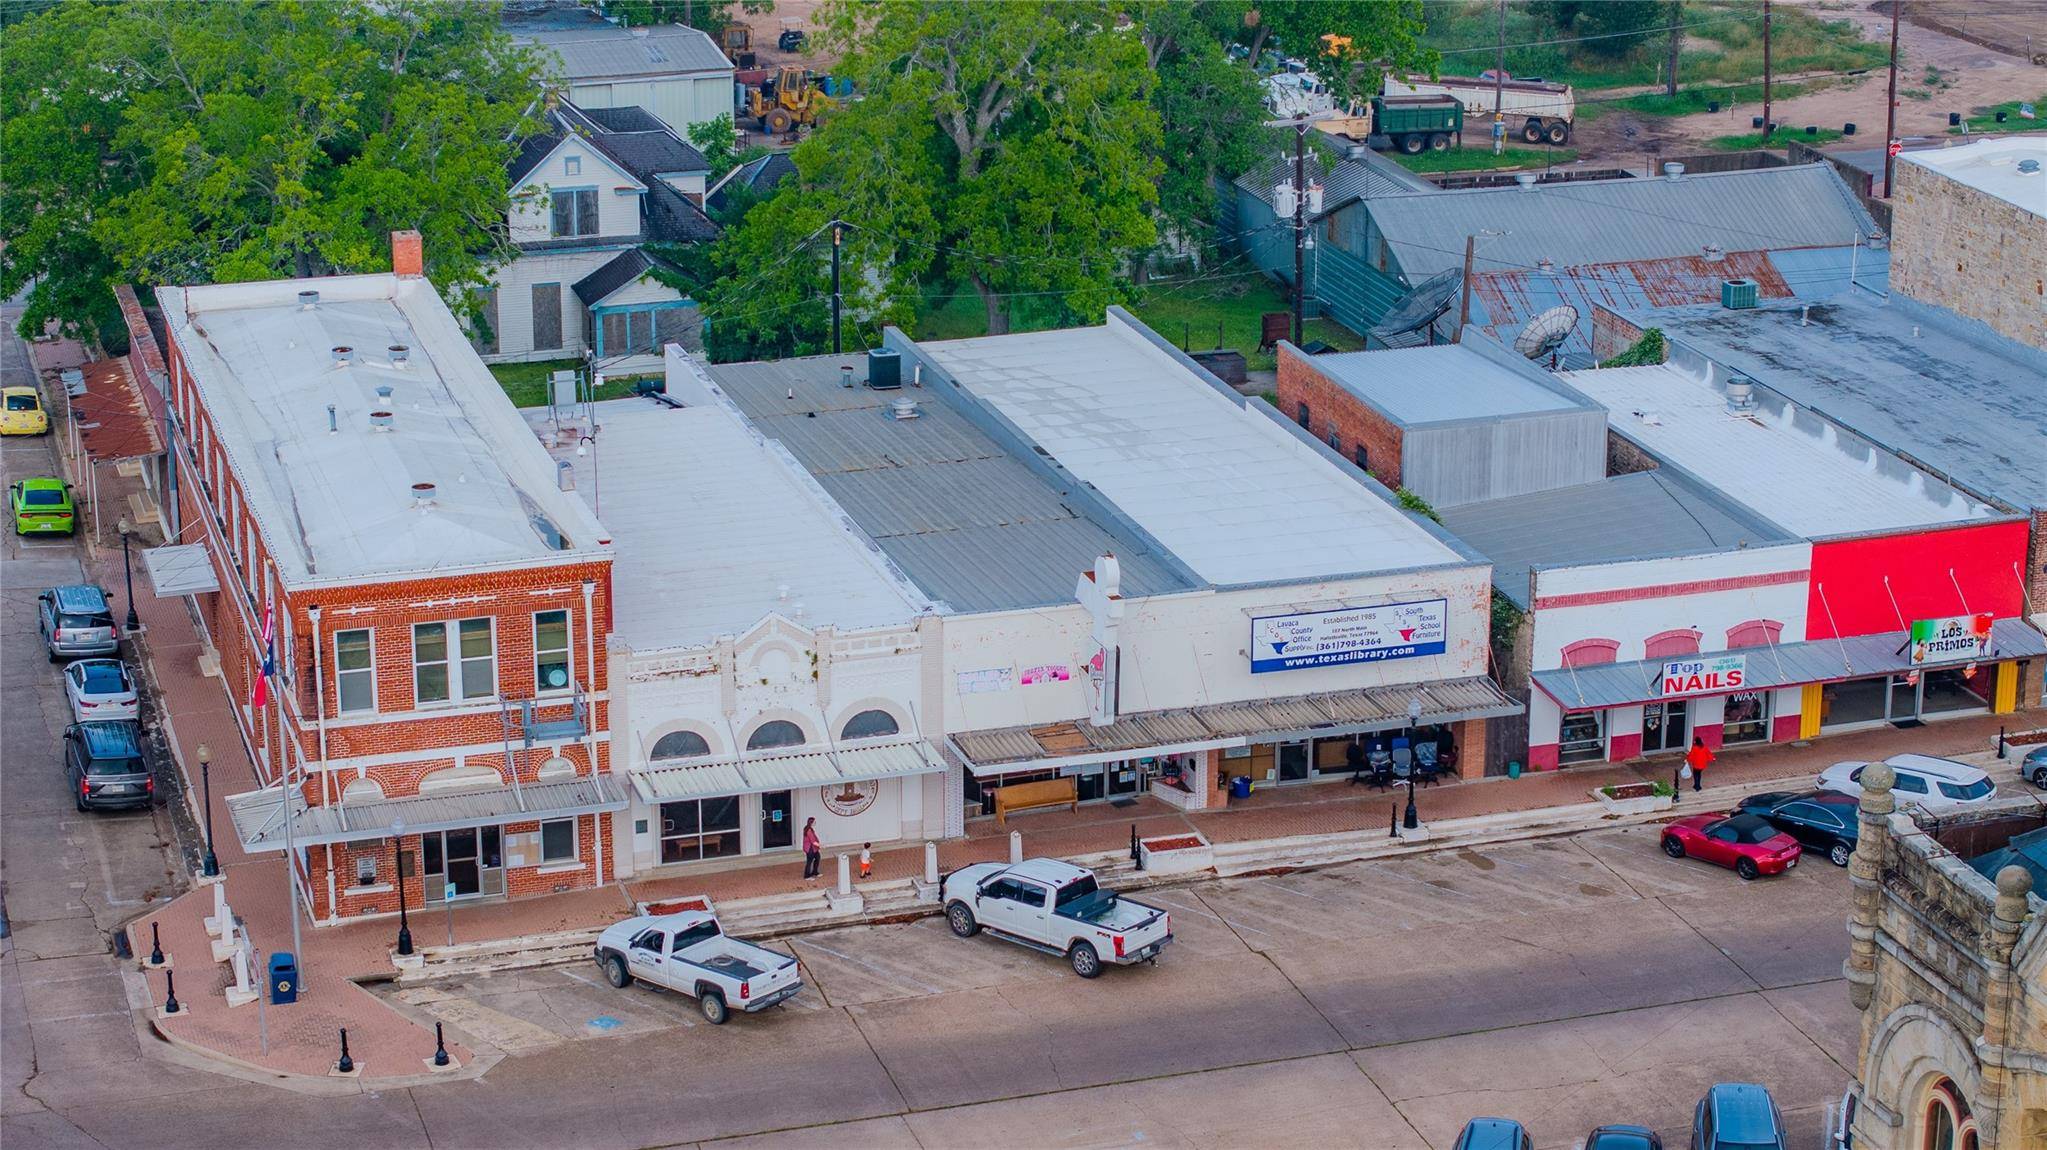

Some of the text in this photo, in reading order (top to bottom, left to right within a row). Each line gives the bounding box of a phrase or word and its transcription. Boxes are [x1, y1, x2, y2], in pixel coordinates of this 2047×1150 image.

[1405, 607, 1424, 615] South
[1322, 612, 1377, 624] Established 1985
[1277, 620, 1299, 628] Lavaca
[1420, 622, 1441, 630] School
[1291, 627, 1313, 635] County
[1412, 631, 1441, 639] Furniture
[1941, 627, 1963, 639] LOS
[1292, 635, 1312, 643] Office
[1284, 644, 1306, 653] Supply
[1316, 637, 1382, 652] (361)798-4364
[1285, 647, 1415, 666] www.texaslibrary.com
[1666, 662, 1705, 675] Top
[1664, 670, 1742, 694] NAILS
[1733, 690, 1758, 702] WAX
